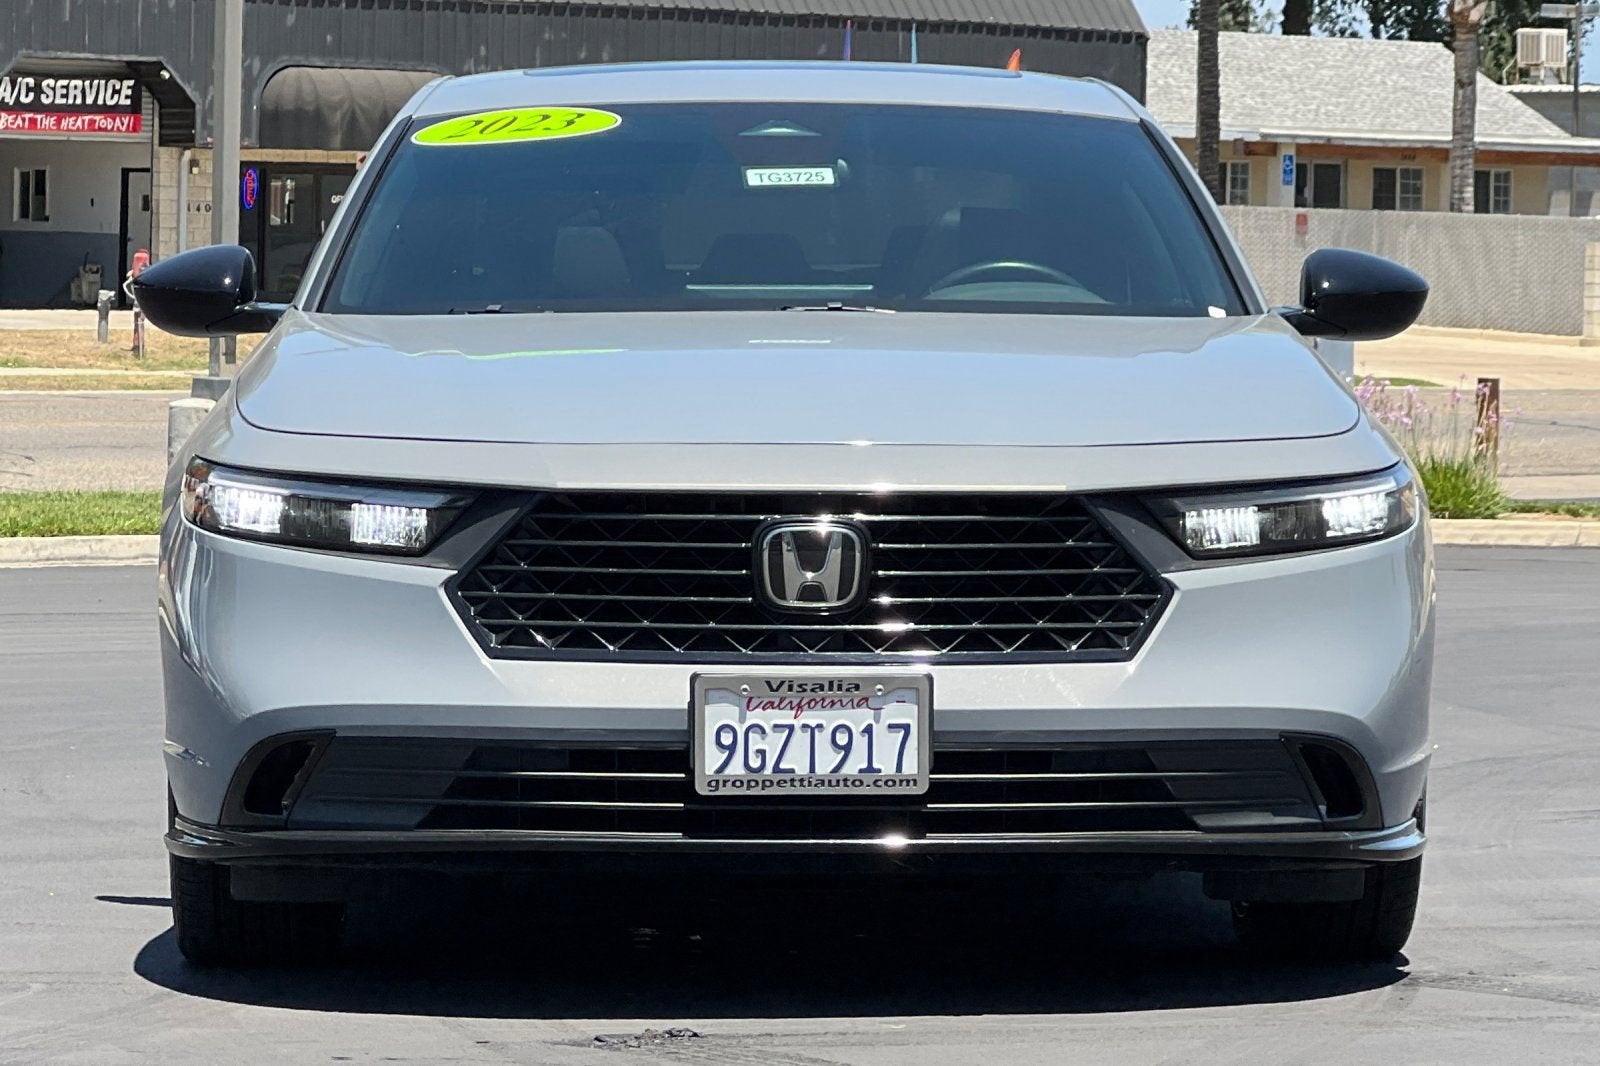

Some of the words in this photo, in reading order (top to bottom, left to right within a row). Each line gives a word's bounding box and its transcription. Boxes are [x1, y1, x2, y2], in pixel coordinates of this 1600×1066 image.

[0, 76, 35, 105] A/C
[40, 78, 135, 106] SERVICE
[0, 113, 34, 129] BEAT
[34, 114, 57, 130] THE
[59, 115, 94, 131] HEAT
[440, 112, 586, 140] 2023
[754, 171, 825, 183] TG3725
[764, 680, 861, 693] Visalia
[714, 722, 912, 774] 9GZT917
[706, 776, 918, 792] groppettiauto.com
